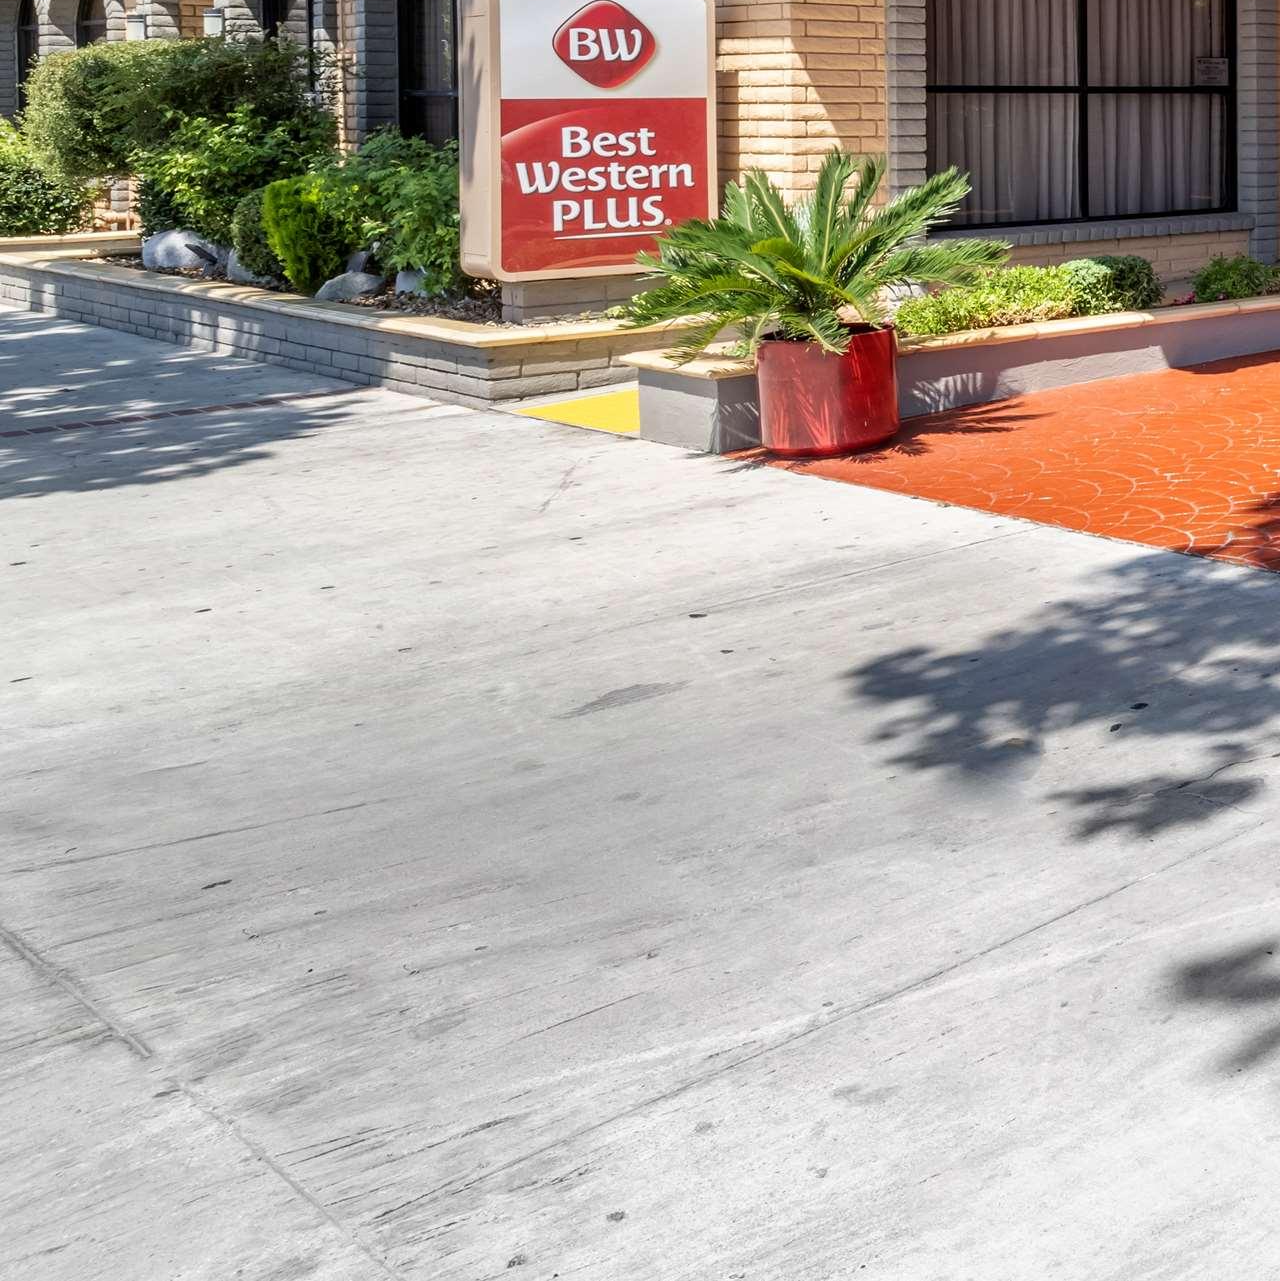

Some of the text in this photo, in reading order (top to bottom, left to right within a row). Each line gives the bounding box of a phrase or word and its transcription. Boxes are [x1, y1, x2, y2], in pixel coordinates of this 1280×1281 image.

[568, 27, 642, 62] BW
[561, 126, 657, 158] Best
[515, 161, 695, 194] Western
[553, 195, 665, 231] PLUS
